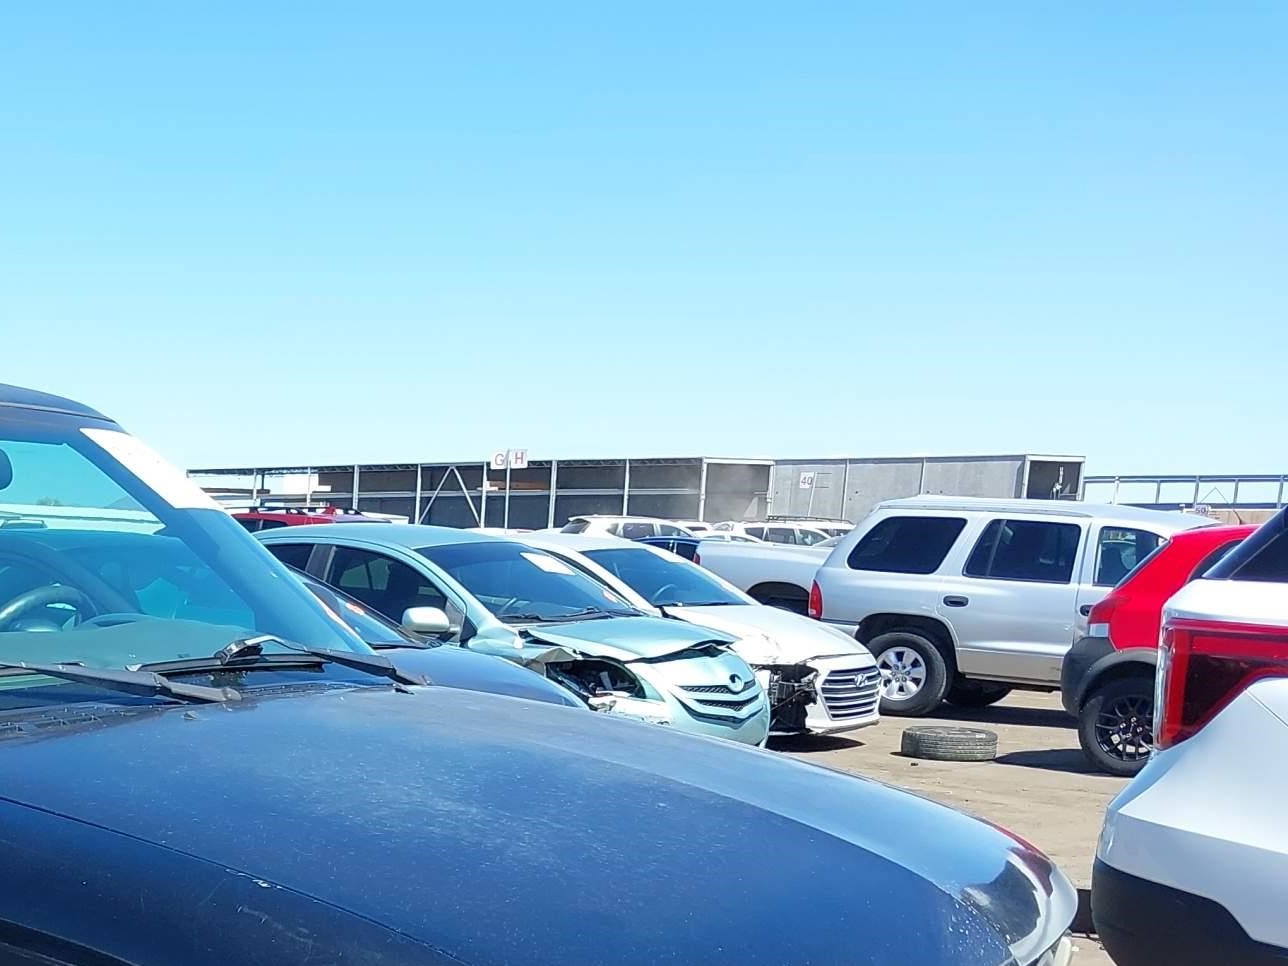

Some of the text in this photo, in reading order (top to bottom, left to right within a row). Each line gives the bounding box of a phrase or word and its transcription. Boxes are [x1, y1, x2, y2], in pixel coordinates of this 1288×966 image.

[494, 453, 505, 466] G
[514, 452, 524, 465] H
[800, 476, 813, 486] 40
